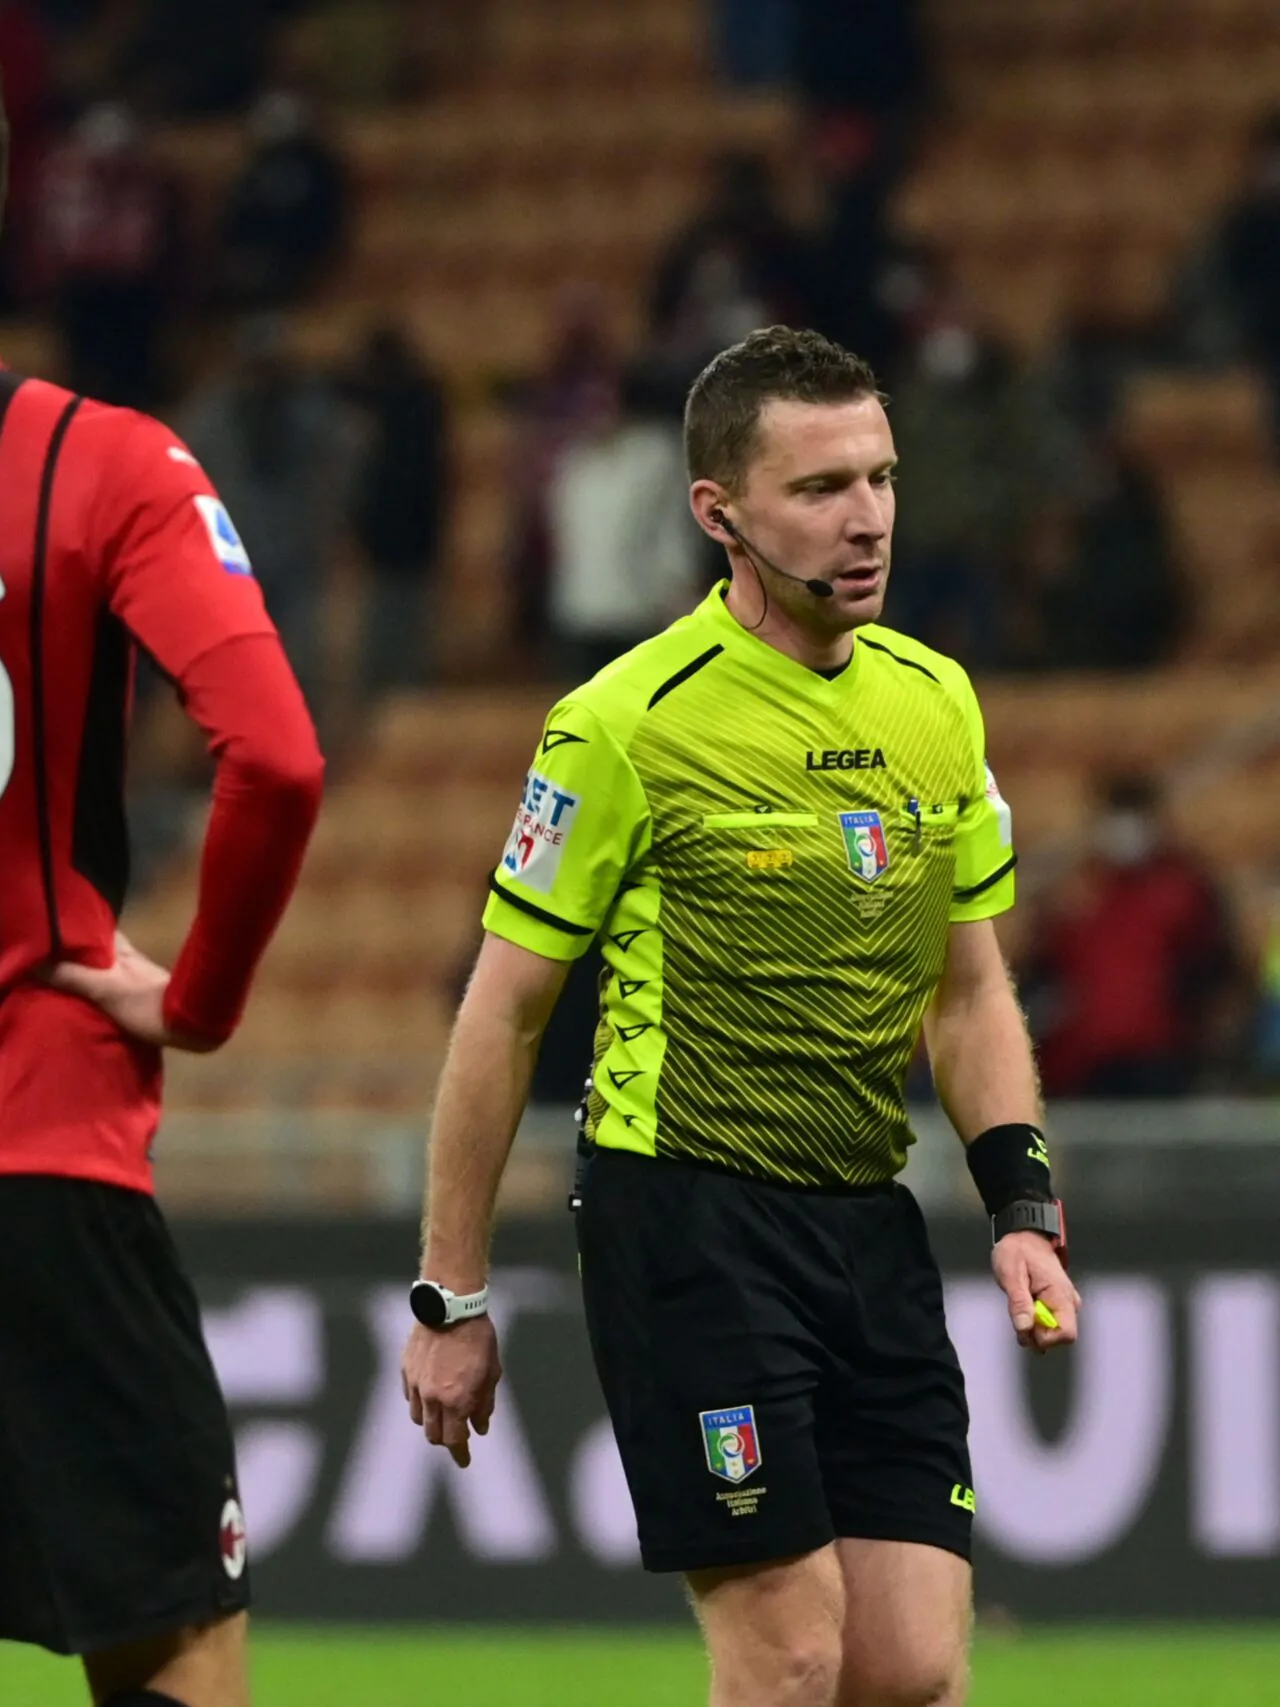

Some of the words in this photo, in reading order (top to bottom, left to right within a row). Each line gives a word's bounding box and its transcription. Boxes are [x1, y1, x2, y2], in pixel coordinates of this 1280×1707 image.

[806, 748, 887, 770] LEGEA
[844, 814, 875, 825] ITALIA
[708, 1412, 745, 1426] ITALIA
